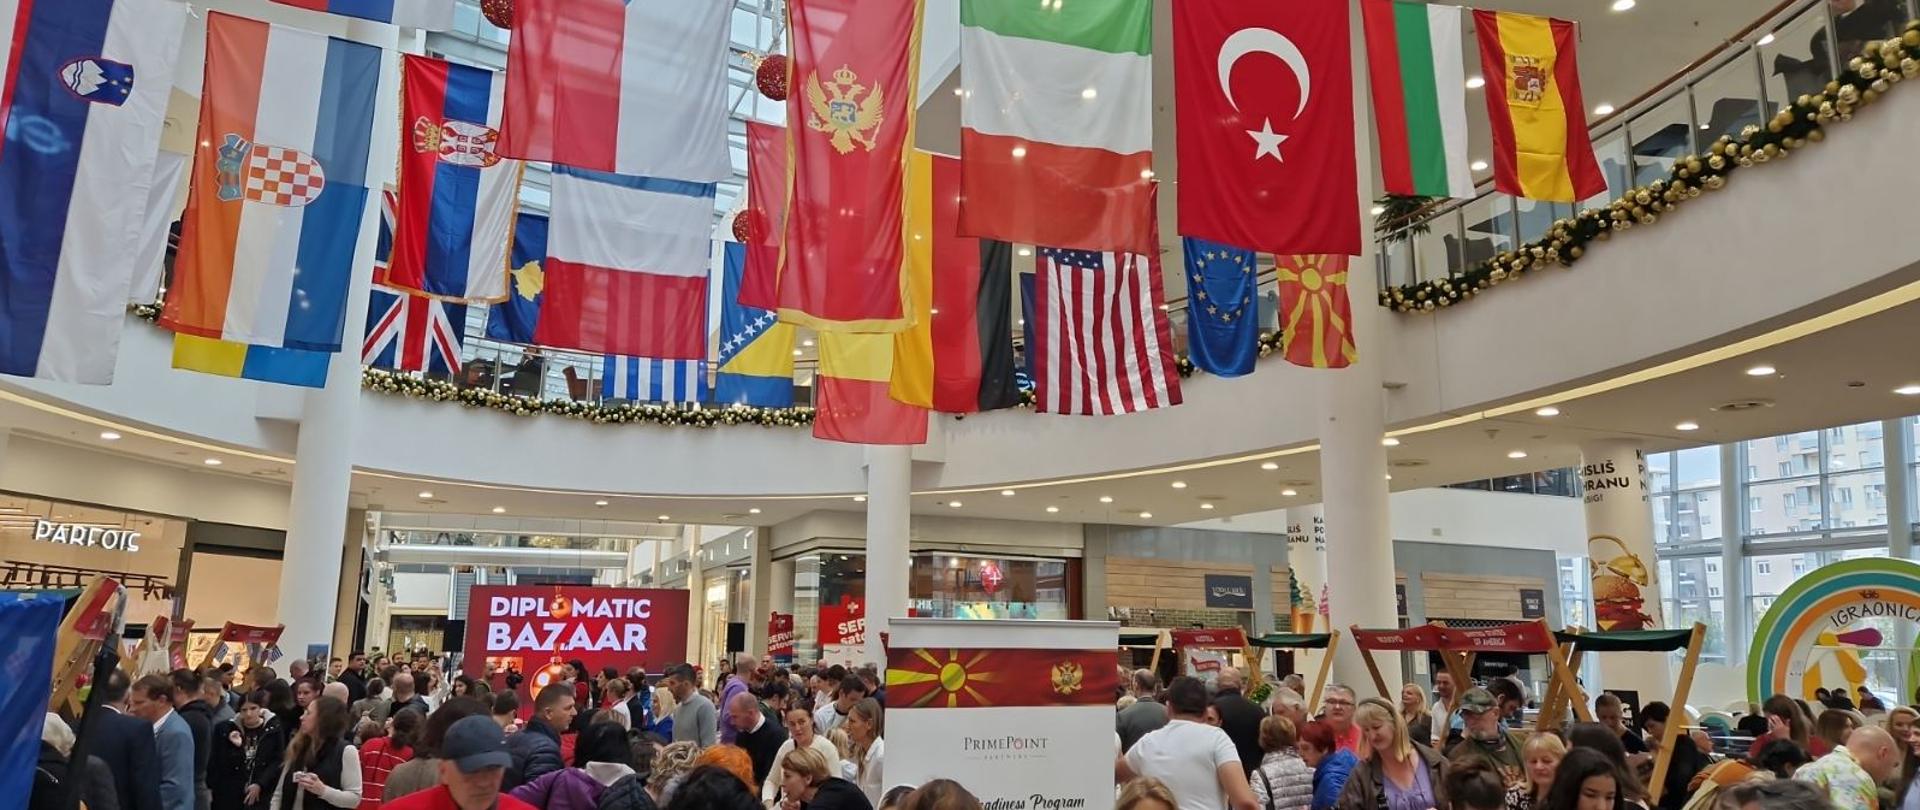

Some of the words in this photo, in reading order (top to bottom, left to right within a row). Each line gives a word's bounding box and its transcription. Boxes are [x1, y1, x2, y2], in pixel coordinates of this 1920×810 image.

[1581, 460, 1616, 477] ISLIŠ
[34, 519, 142, 552] PARFOIS
[486, 621, 648, 651] BAZAAR
[1029, 793, 1085, 810] Program
